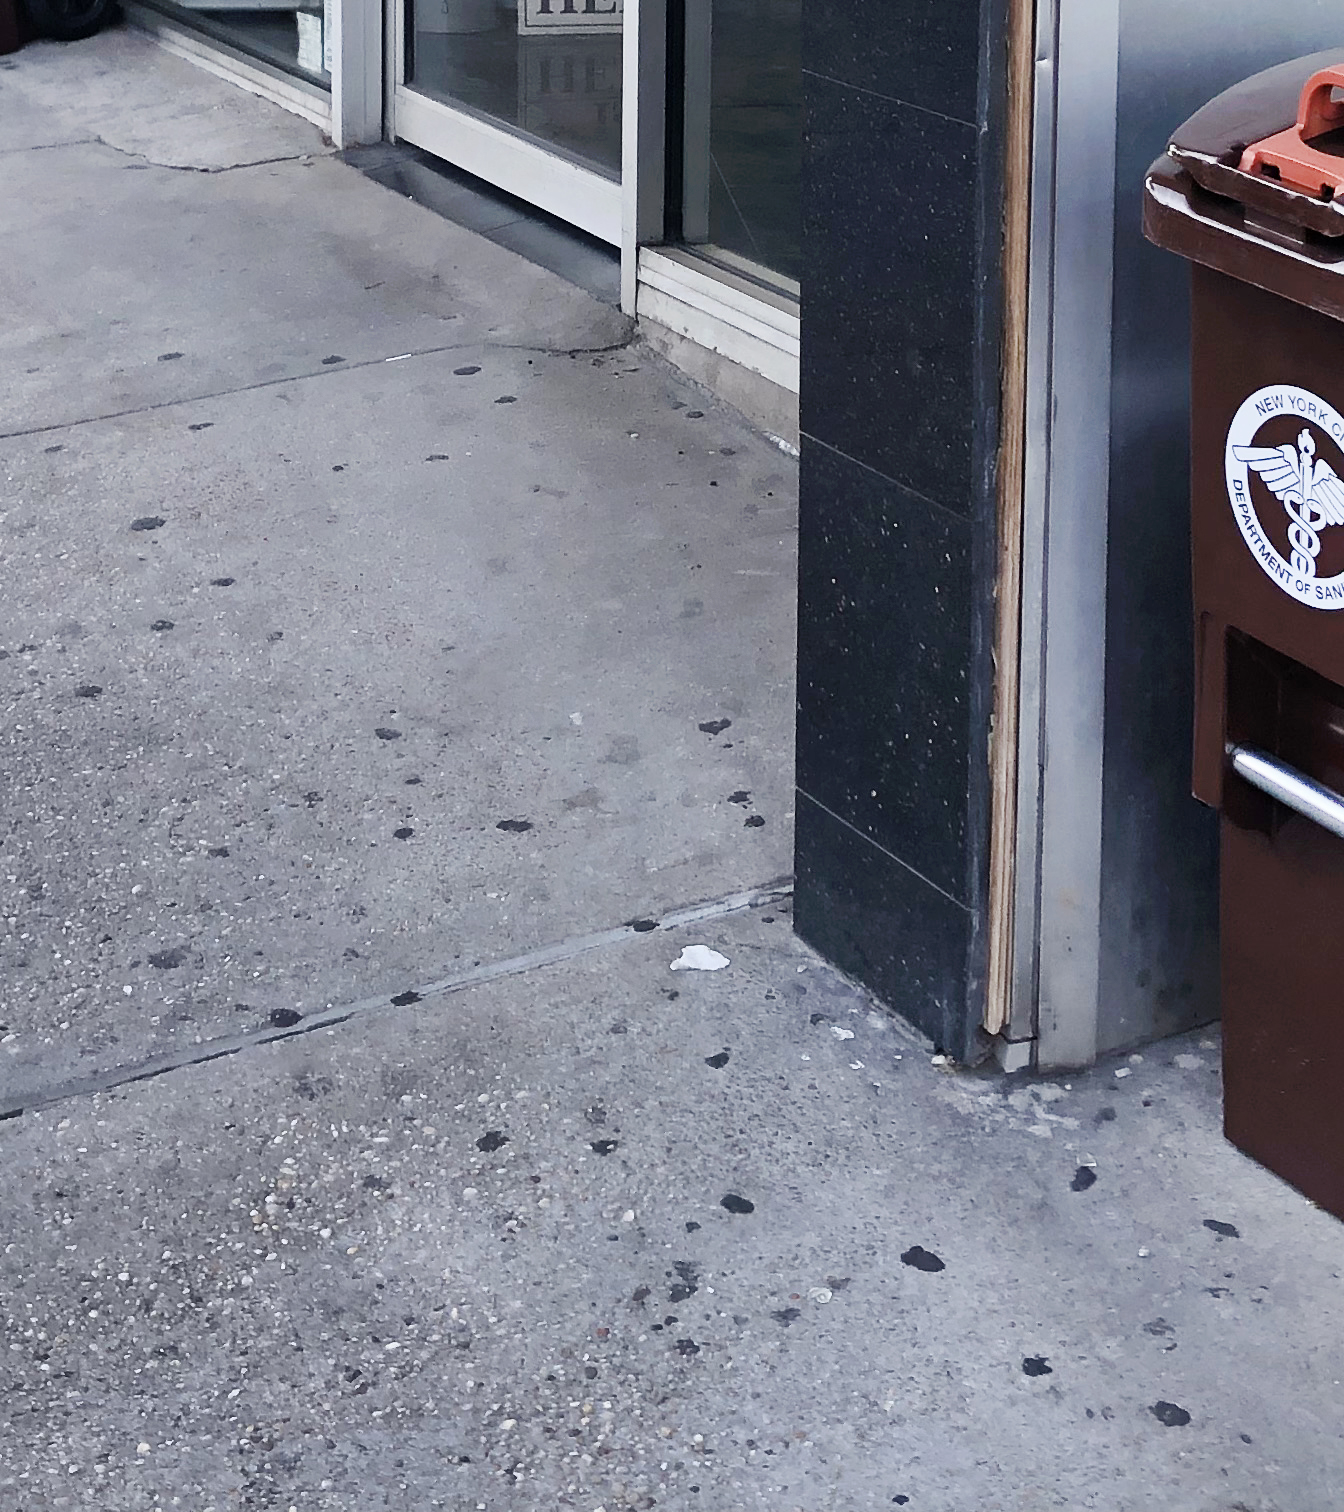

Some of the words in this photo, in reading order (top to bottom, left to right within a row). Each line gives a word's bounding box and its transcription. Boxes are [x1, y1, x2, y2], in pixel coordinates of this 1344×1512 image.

[1254, 393, 1285, 417] NEW
[1288, 394, 1329, 426] YORK
[1231, 478, 1294, 585] DEPARTMENT
[1294, 578, 1312, 595] OF
